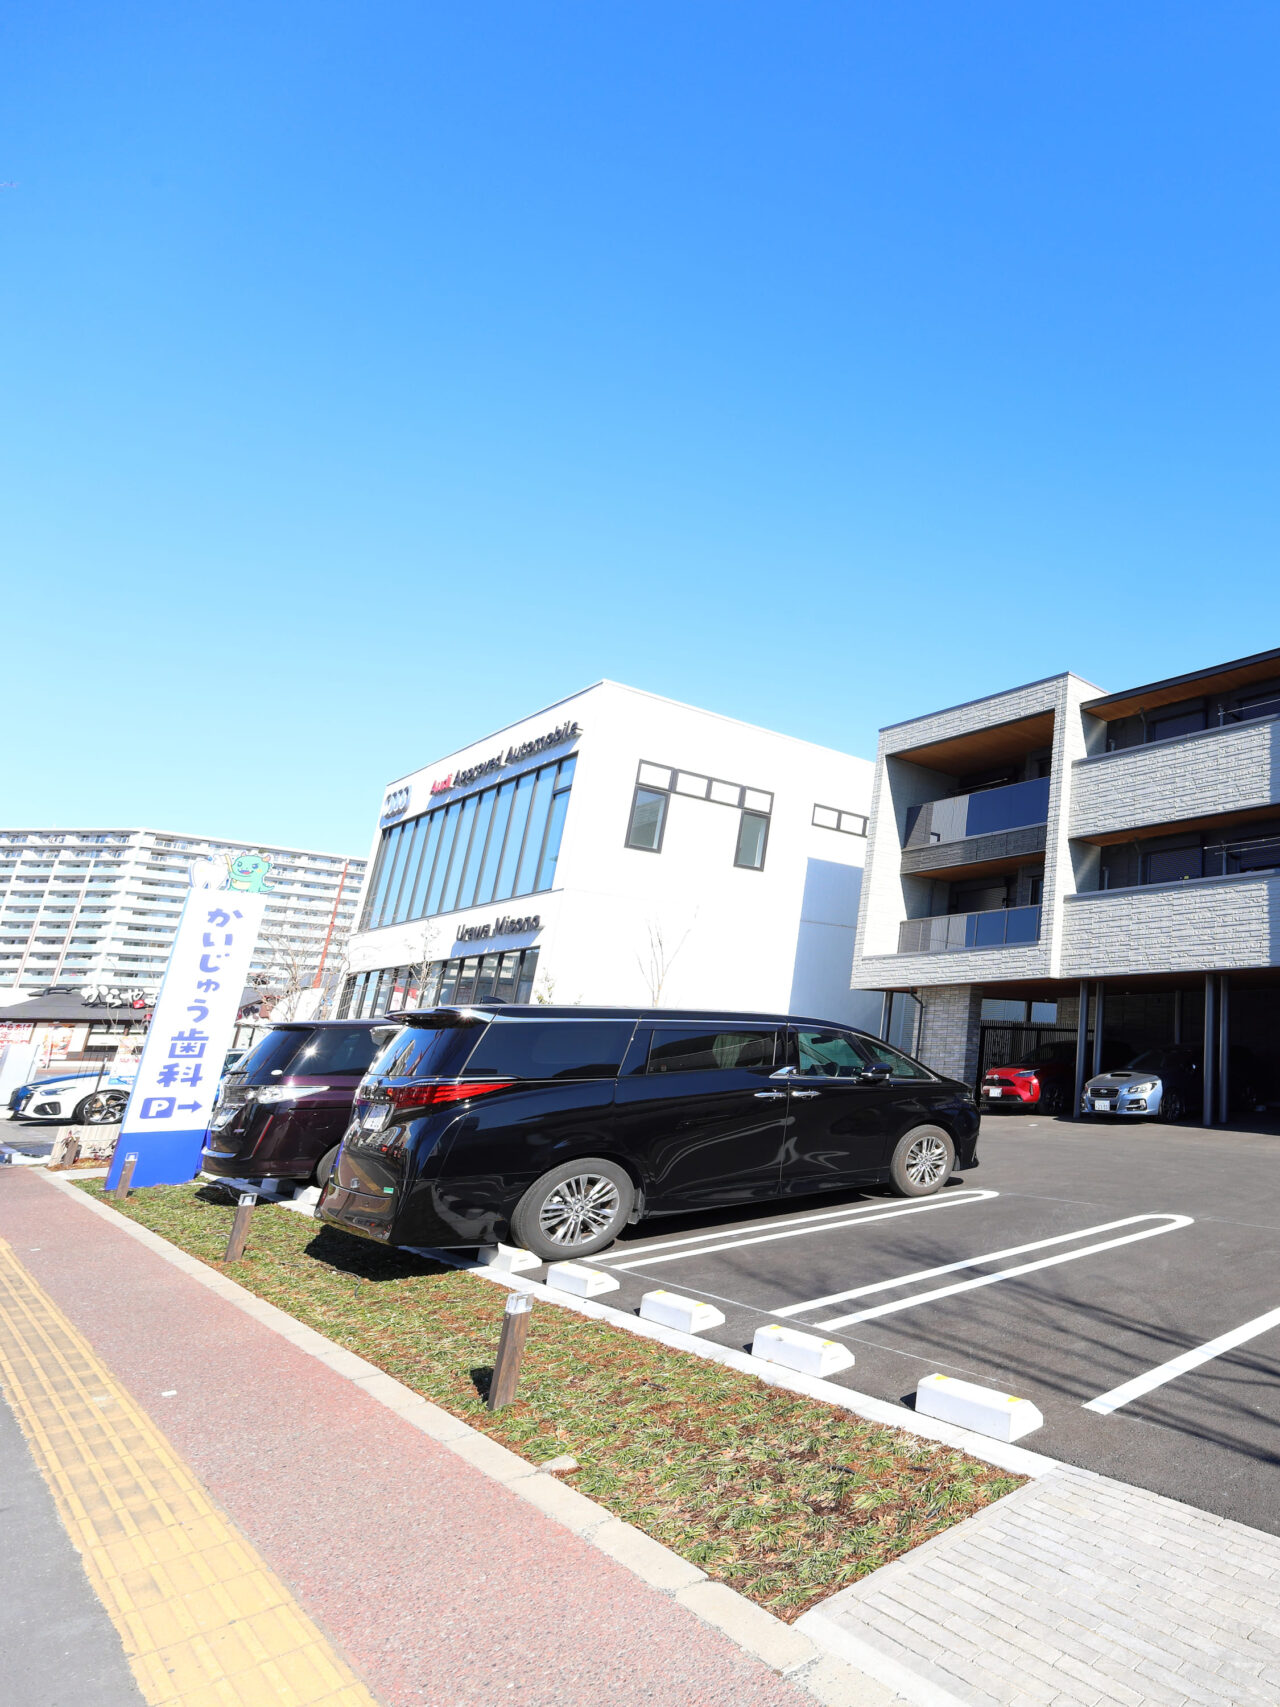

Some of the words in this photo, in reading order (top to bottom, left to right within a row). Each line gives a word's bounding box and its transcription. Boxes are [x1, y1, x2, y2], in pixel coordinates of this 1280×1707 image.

[430, 773, 453, 796] Audi
[453, 750, 505, 786] Approved
[505, 720, 583, 764] Automobile
[456, 923, 490, 942] Urawa
[493, 914, 544, 938] Misono
[157, 908, 243, 1088] かいじゅう歯科
